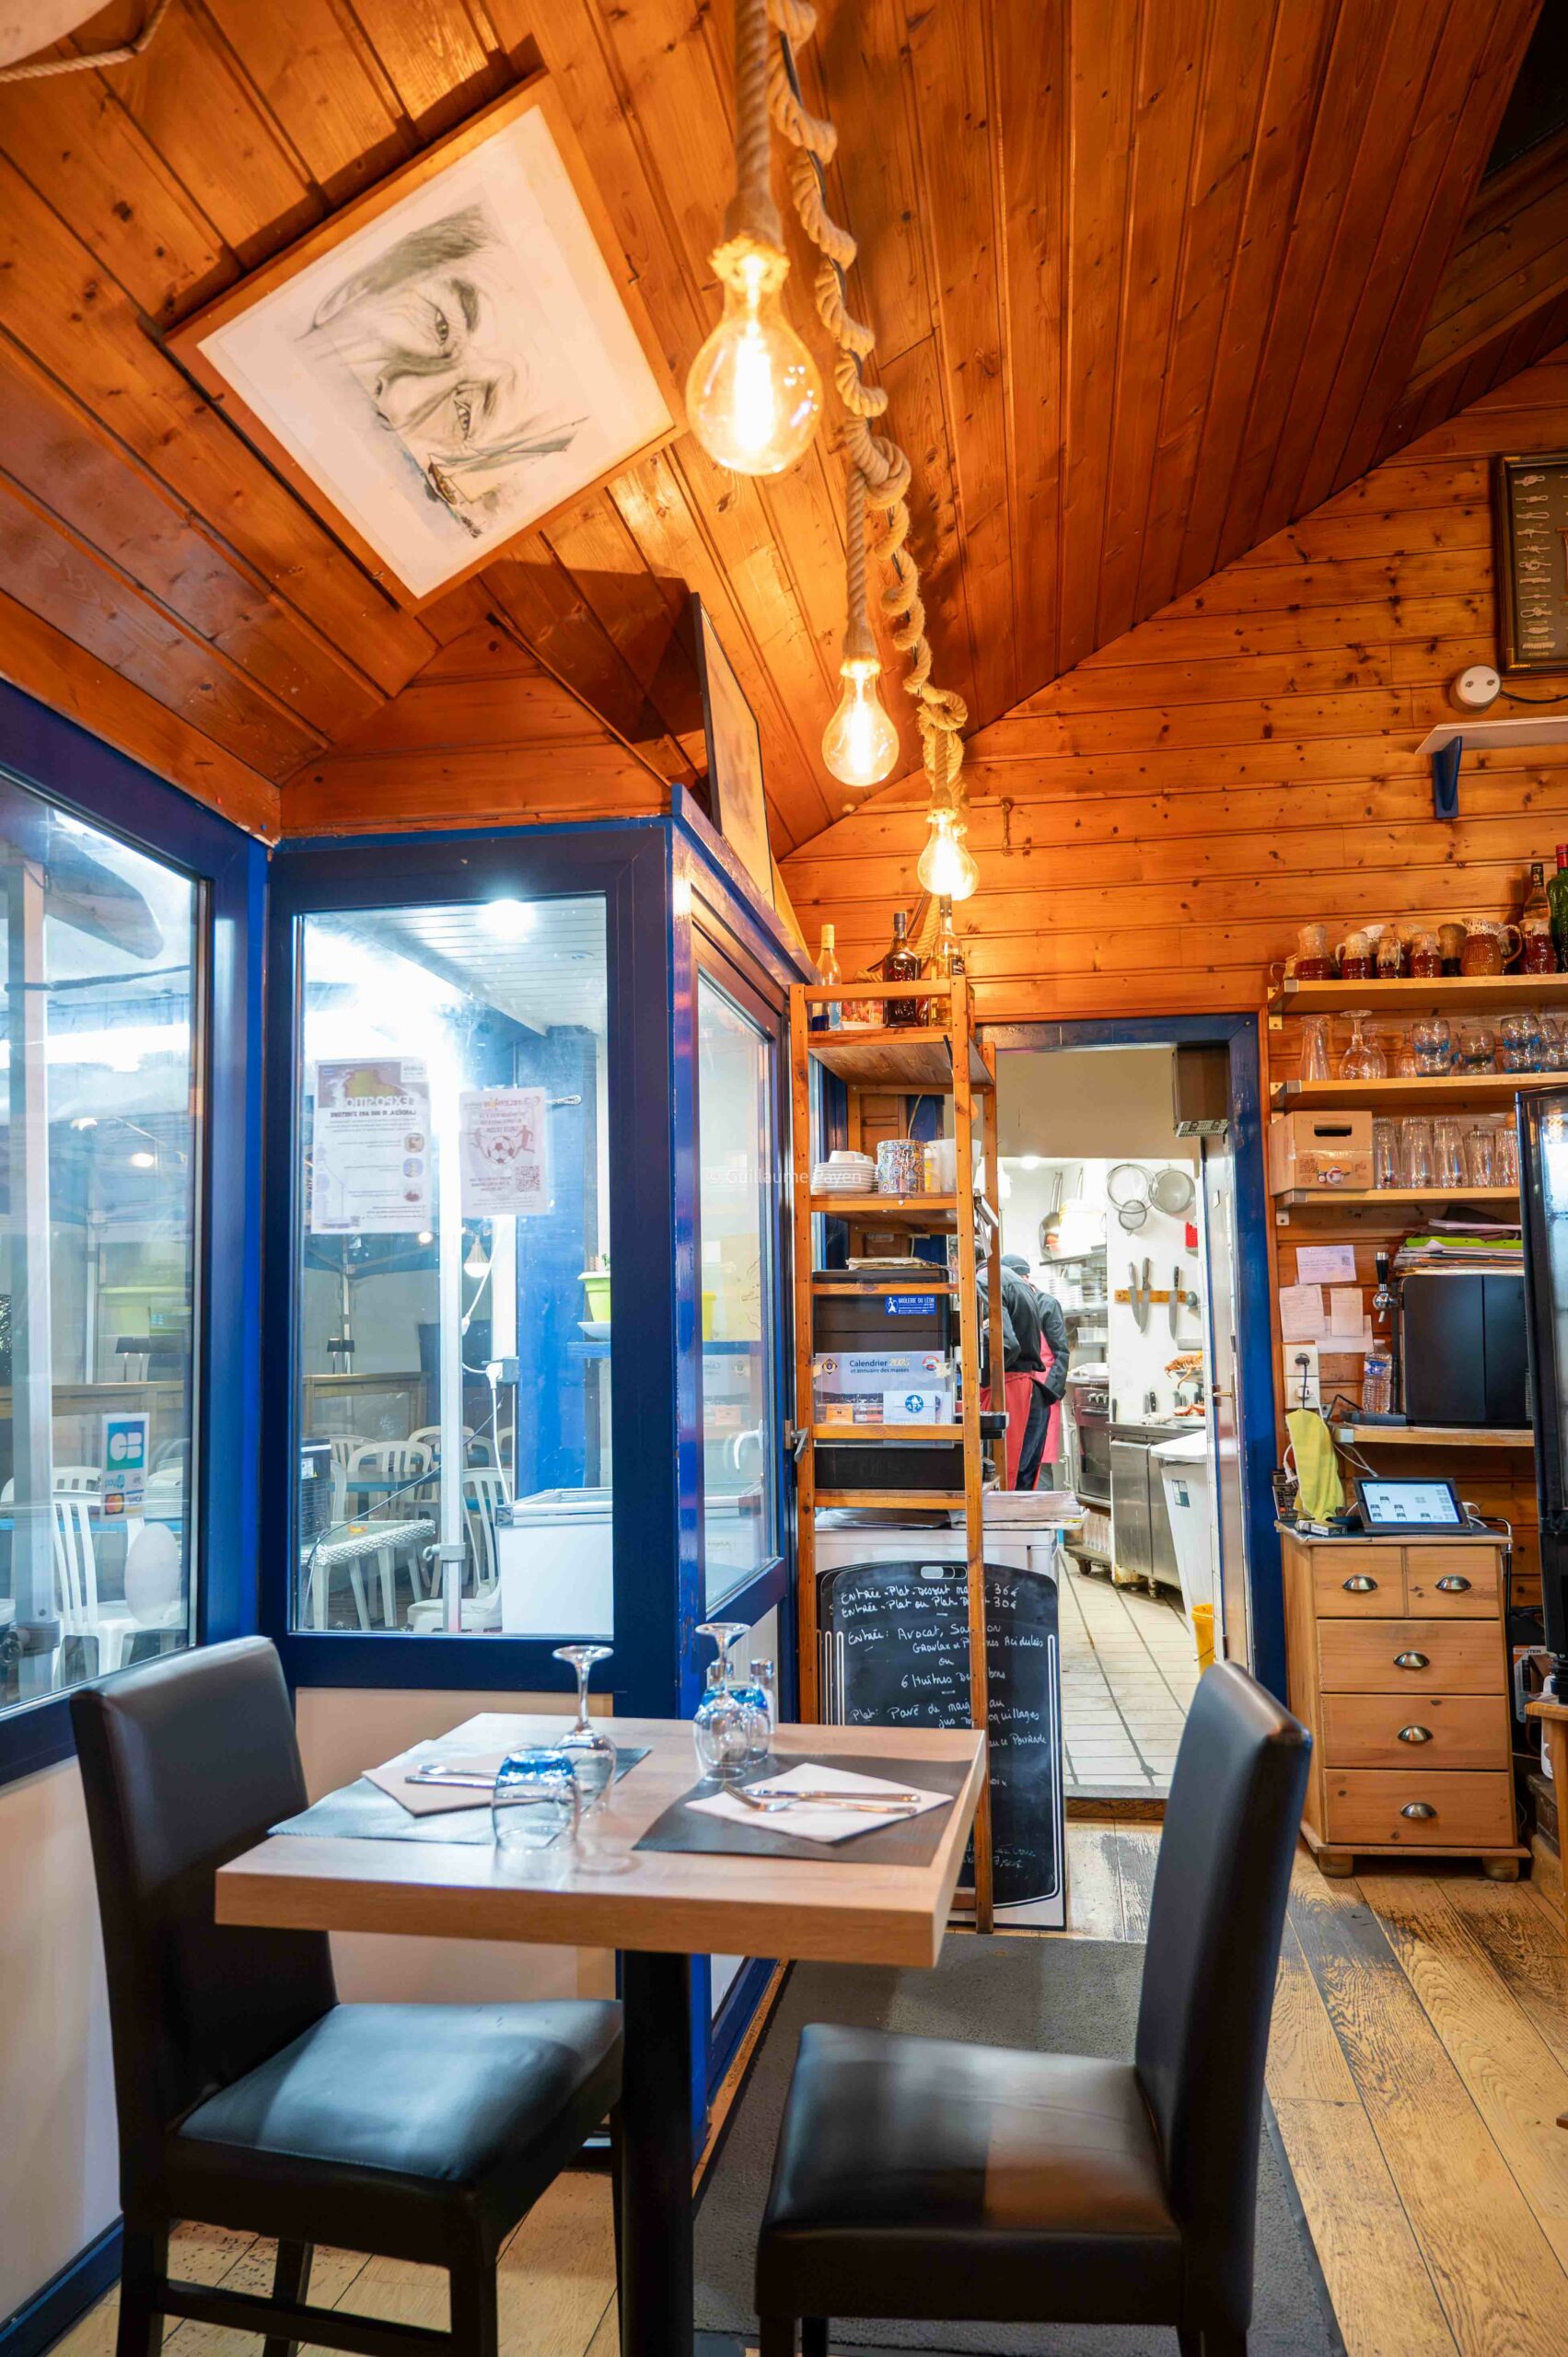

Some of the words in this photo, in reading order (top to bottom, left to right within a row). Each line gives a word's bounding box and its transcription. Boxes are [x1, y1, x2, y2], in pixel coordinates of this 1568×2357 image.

[849, 1359, 888, 1367] Calendrier
[110, 1432, 143, 1461] CB
[938, 1657, 955, 1666] ou
[900, 1675, 909, 1689] 6
[887, 1703, 920, 1720] Pavé
[988, 1708, 1040, 1724] oquillages
